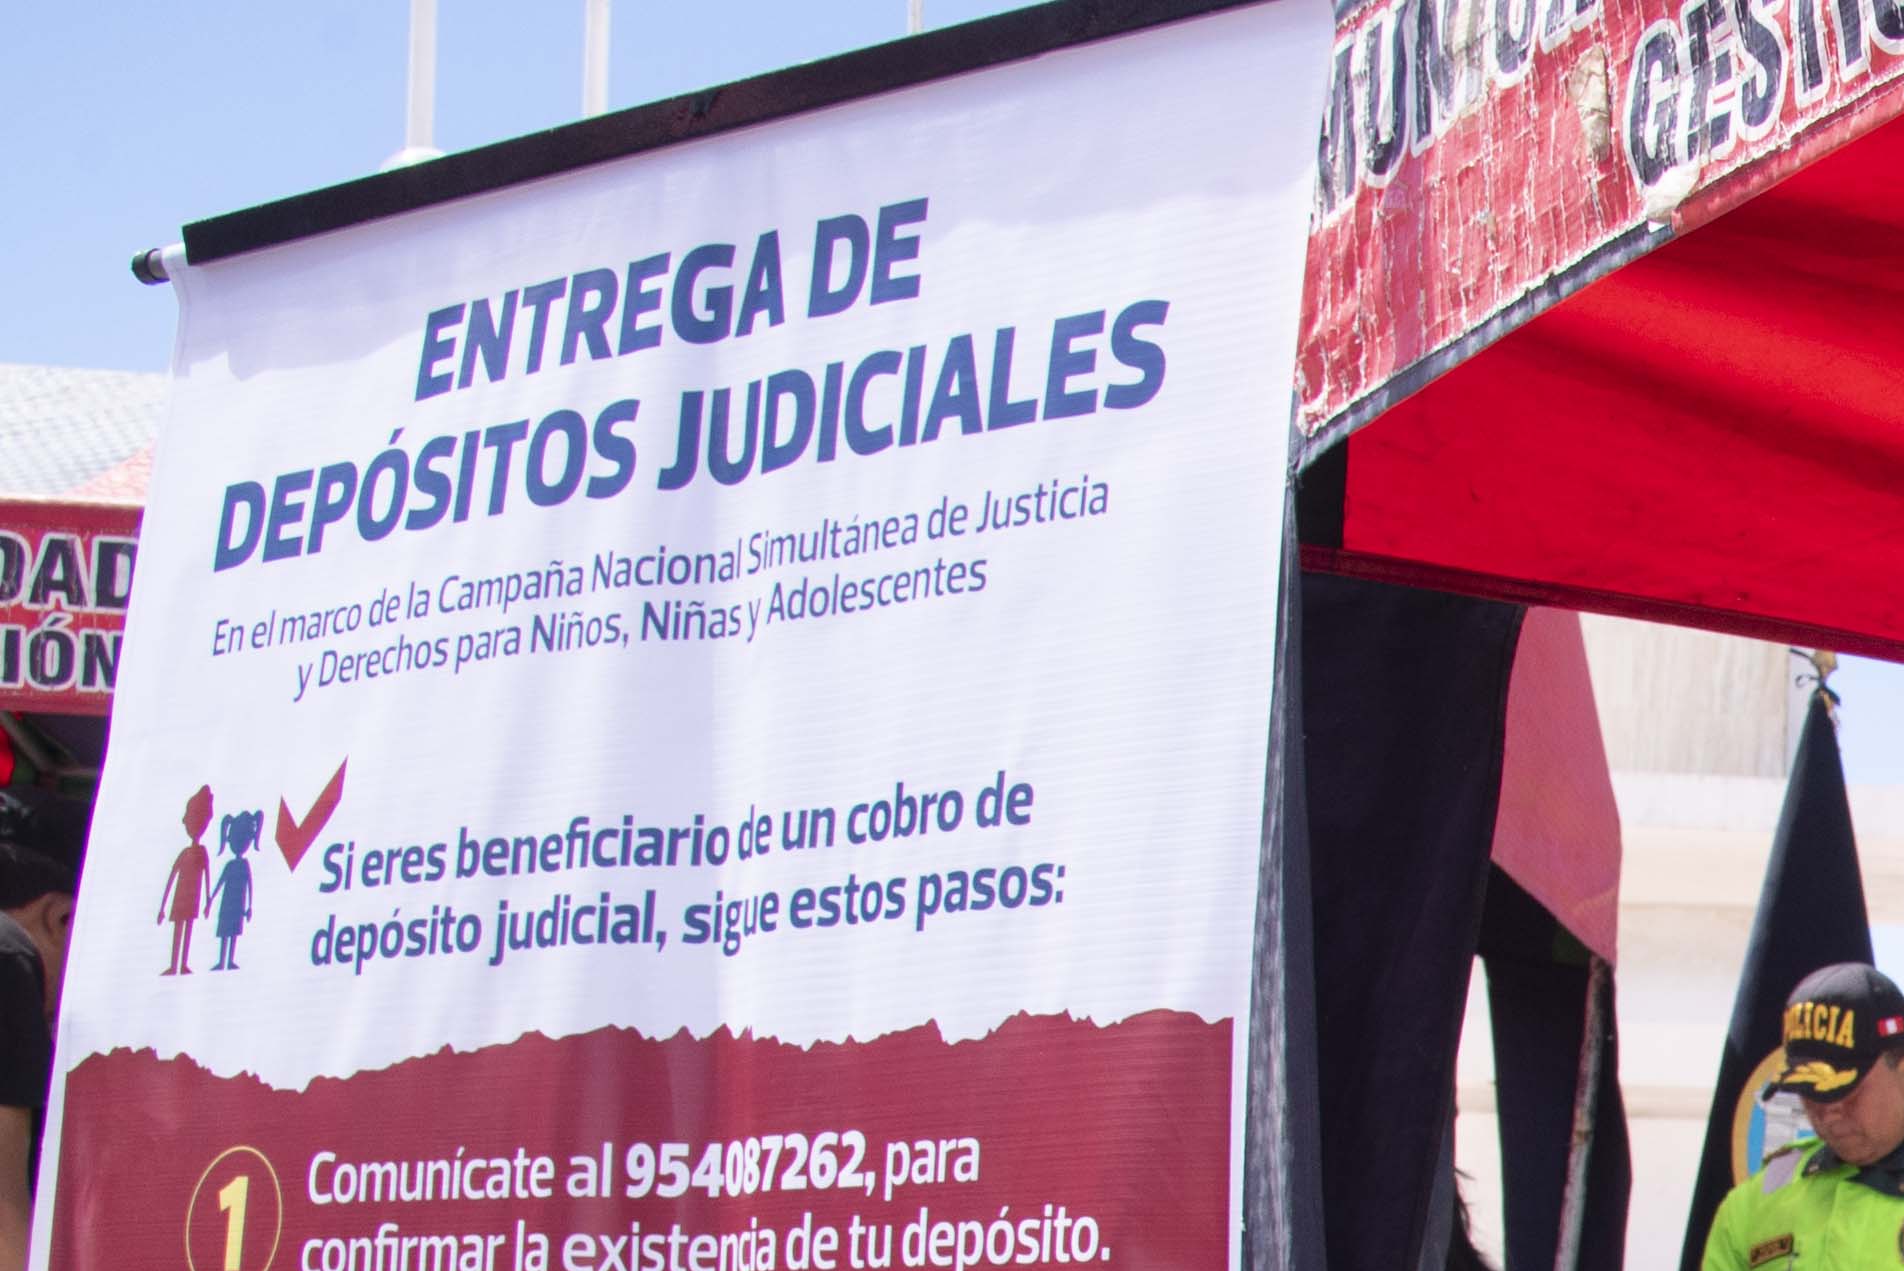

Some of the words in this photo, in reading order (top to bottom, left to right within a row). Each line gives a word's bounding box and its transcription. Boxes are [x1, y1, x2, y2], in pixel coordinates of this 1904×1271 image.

[415, 230, 785, 402] ENTREGA
[808, 197, 929, 317] DE
[214, 399, 640, 572] DEPÓSITOS
[657, 299, 1170, 491] JUDICIALES
[212, 620, 243, 656] En
[251, 610, 276, 649] el
[280, 602, 361, 645] marco
[368, 588, 400, 626] de
[407, 582, 429, 620] la
[438, 561, 583, 613] Campaña
[593, 538, 741, 593] Nacional
[747, 515, 918, 575] Simultánea
[927, 496, 968, 538] de
[976, 475, 1109, 533] Justicia
[294, 658, 313, 702] y
[319, 634, 447, 688] Derechos
[455, 626, 520, 674] para
[530, 609, 629, 653] Niños,
[641, 600, 741, 641] Niñas
[747, 601, 761, 642] y
[767, 558, 987, 625] Adolescentes
[319, 842, 355, 892] Si
[362, 843, 446, 886] eres
[456, 814, 729, 879] beneficiario
[738, 804, 772, 860] de
[782, 805, 835, 850] un
[847, 782, 964, 845] cobro
[976, 770, 1034, 827] de
[311, 905, 481, 976] depósito
[489, 890, 667, 966] judicial,
[682, 891, 779, 956] sigue
[789, 874, 906, 927] estos
[916, 862, 1065, 931] pasos:
[218, 1176, 249, 1271] 1
[308, 1146, 554, 1204] Comunícate
[566, 1142, 612, 1197] al
[626, 1130, 875, 1198] 954087262,
[885, 1137, 979, 1201] para
[785, 1212, 838, 1270] de
[848, 1216, 892, 1268] tu
